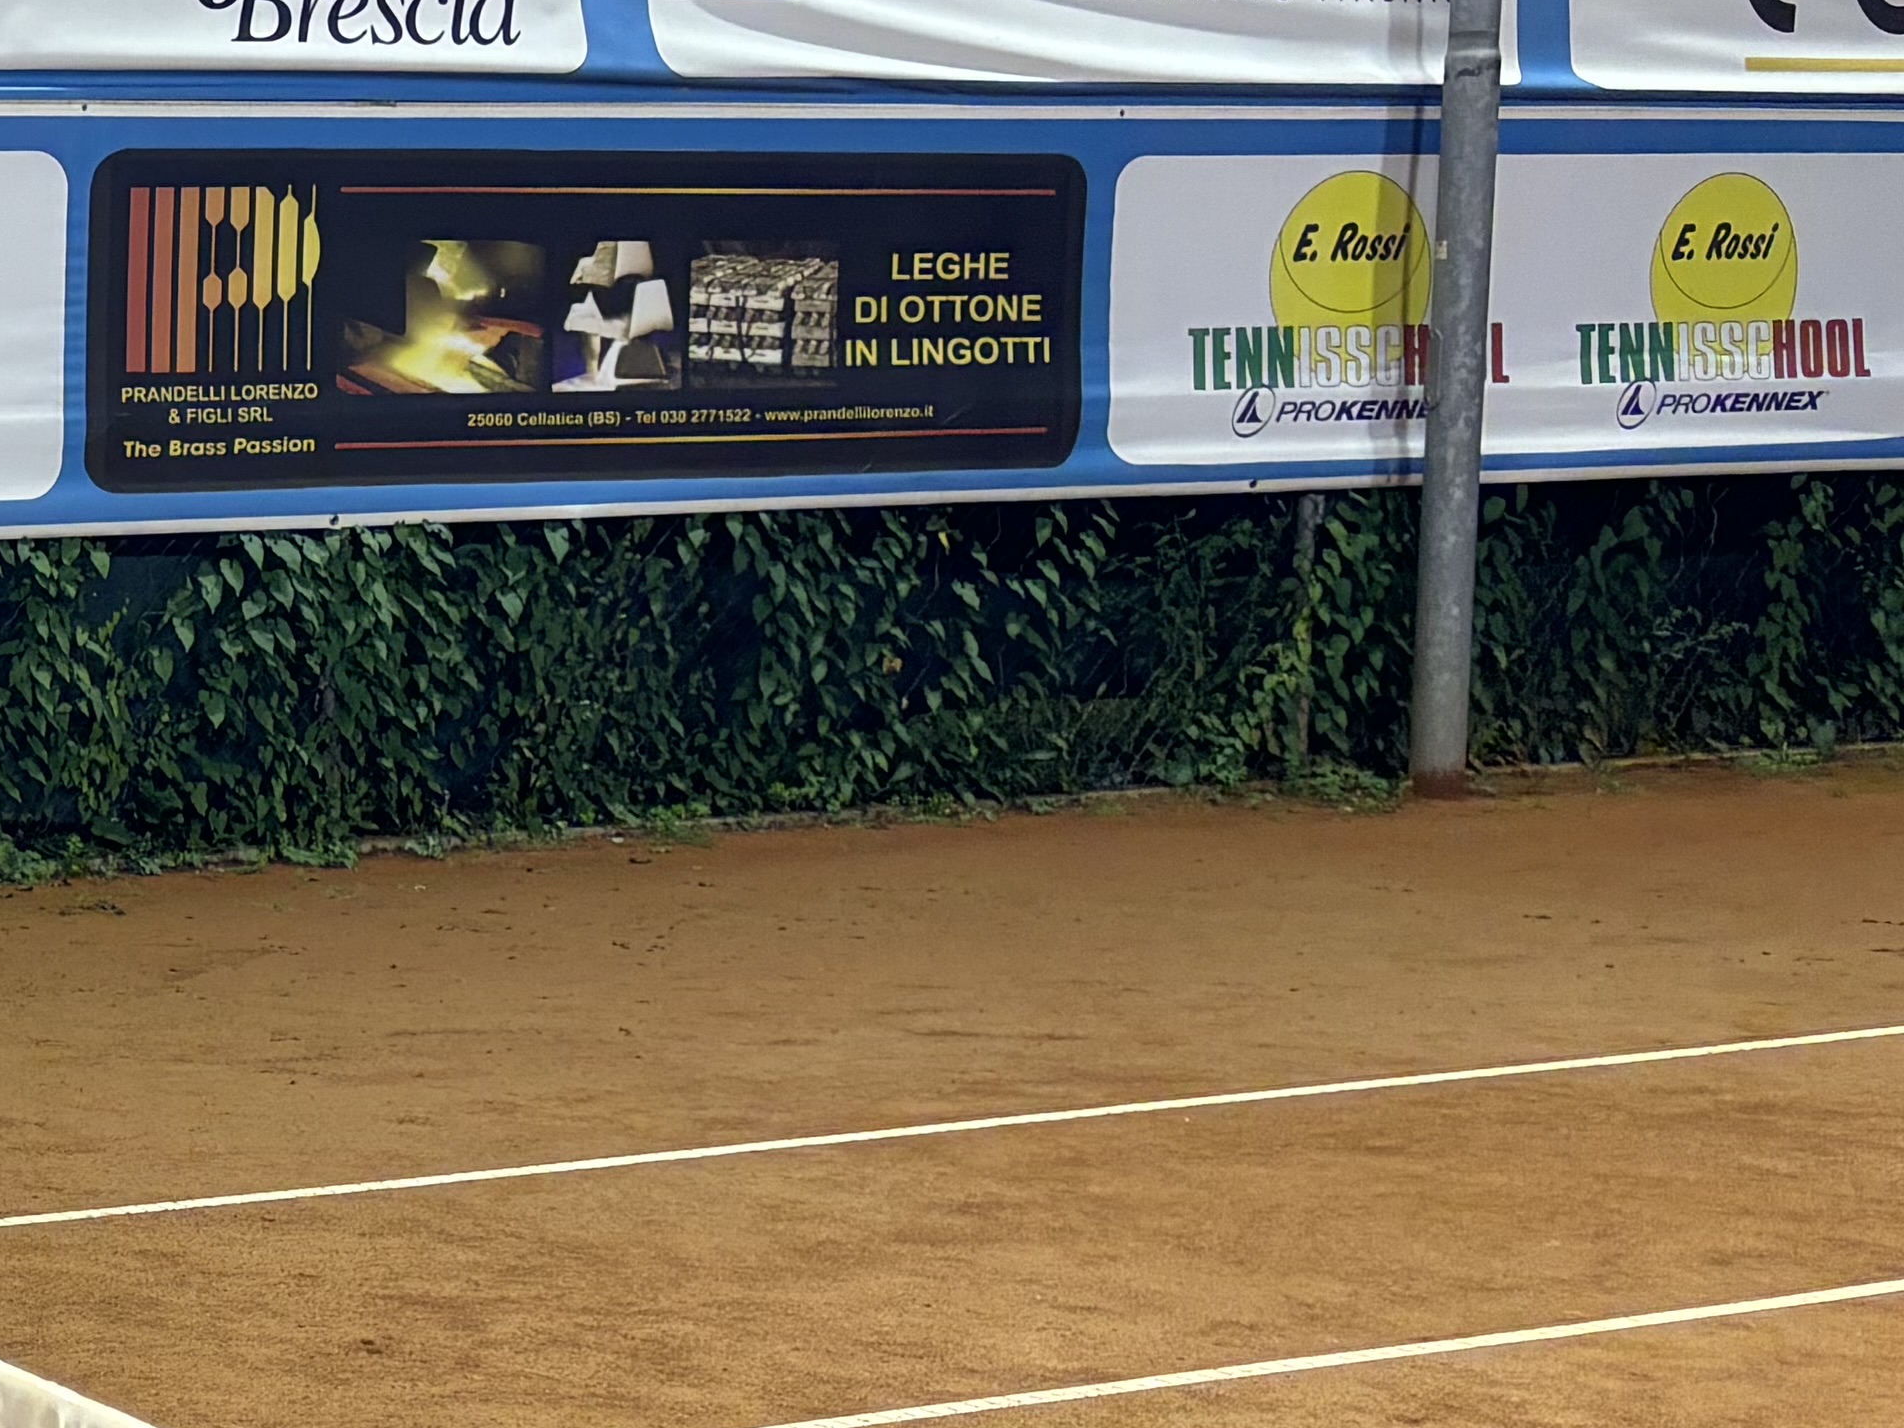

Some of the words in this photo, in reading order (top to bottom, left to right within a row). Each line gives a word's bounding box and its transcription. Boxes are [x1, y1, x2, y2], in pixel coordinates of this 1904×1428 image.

[1292, 223, 1320, 263] E.
[1330, 222, 1411, 262] Rossi
[1671, 223, 1697, 261] E.
[1705, 222, 1780, 260] Rossi
[891, 252, 1011, 281] LEGHE
[854, 295, 888, 324] DI
[899, 294, 1042, 323] OTTONE
[845, 338, 878, 367] IN
[891, 336, 1051, 366] LINGOTTI
[1188, 322, 1510, 390] TENNISSCHL
[1575, 318, 1872, 385] TENNISSCHOOL
[121, 385, 226, 403] PRANDELLI
[230, 383, 319, 401] LORENZO
[1656, 390, 1824, 415] PROKENNEX
[168, 408, 181, 424] &
[186, 407, 232, 424] FIGLI
[237, 406, 273, 422] SRL
[467, 413, 513, 427] 25060
[517, 411, 585, 426] Cellatica
[588, 410, 621, 428] (BS)
[635, 410, 656, 424] Tel
[660, 409, 686, 424] 030
[691, 408, 751, 423] 2771522
[765, 404, 934, 422] www.prandellilorenzo.it
[1275, 400, 1430, 422] PROKENNE
[123, 440, 162, 458] The
[169, 439, 227, 456] Brass
[233, 436, 316, 455] Passion
